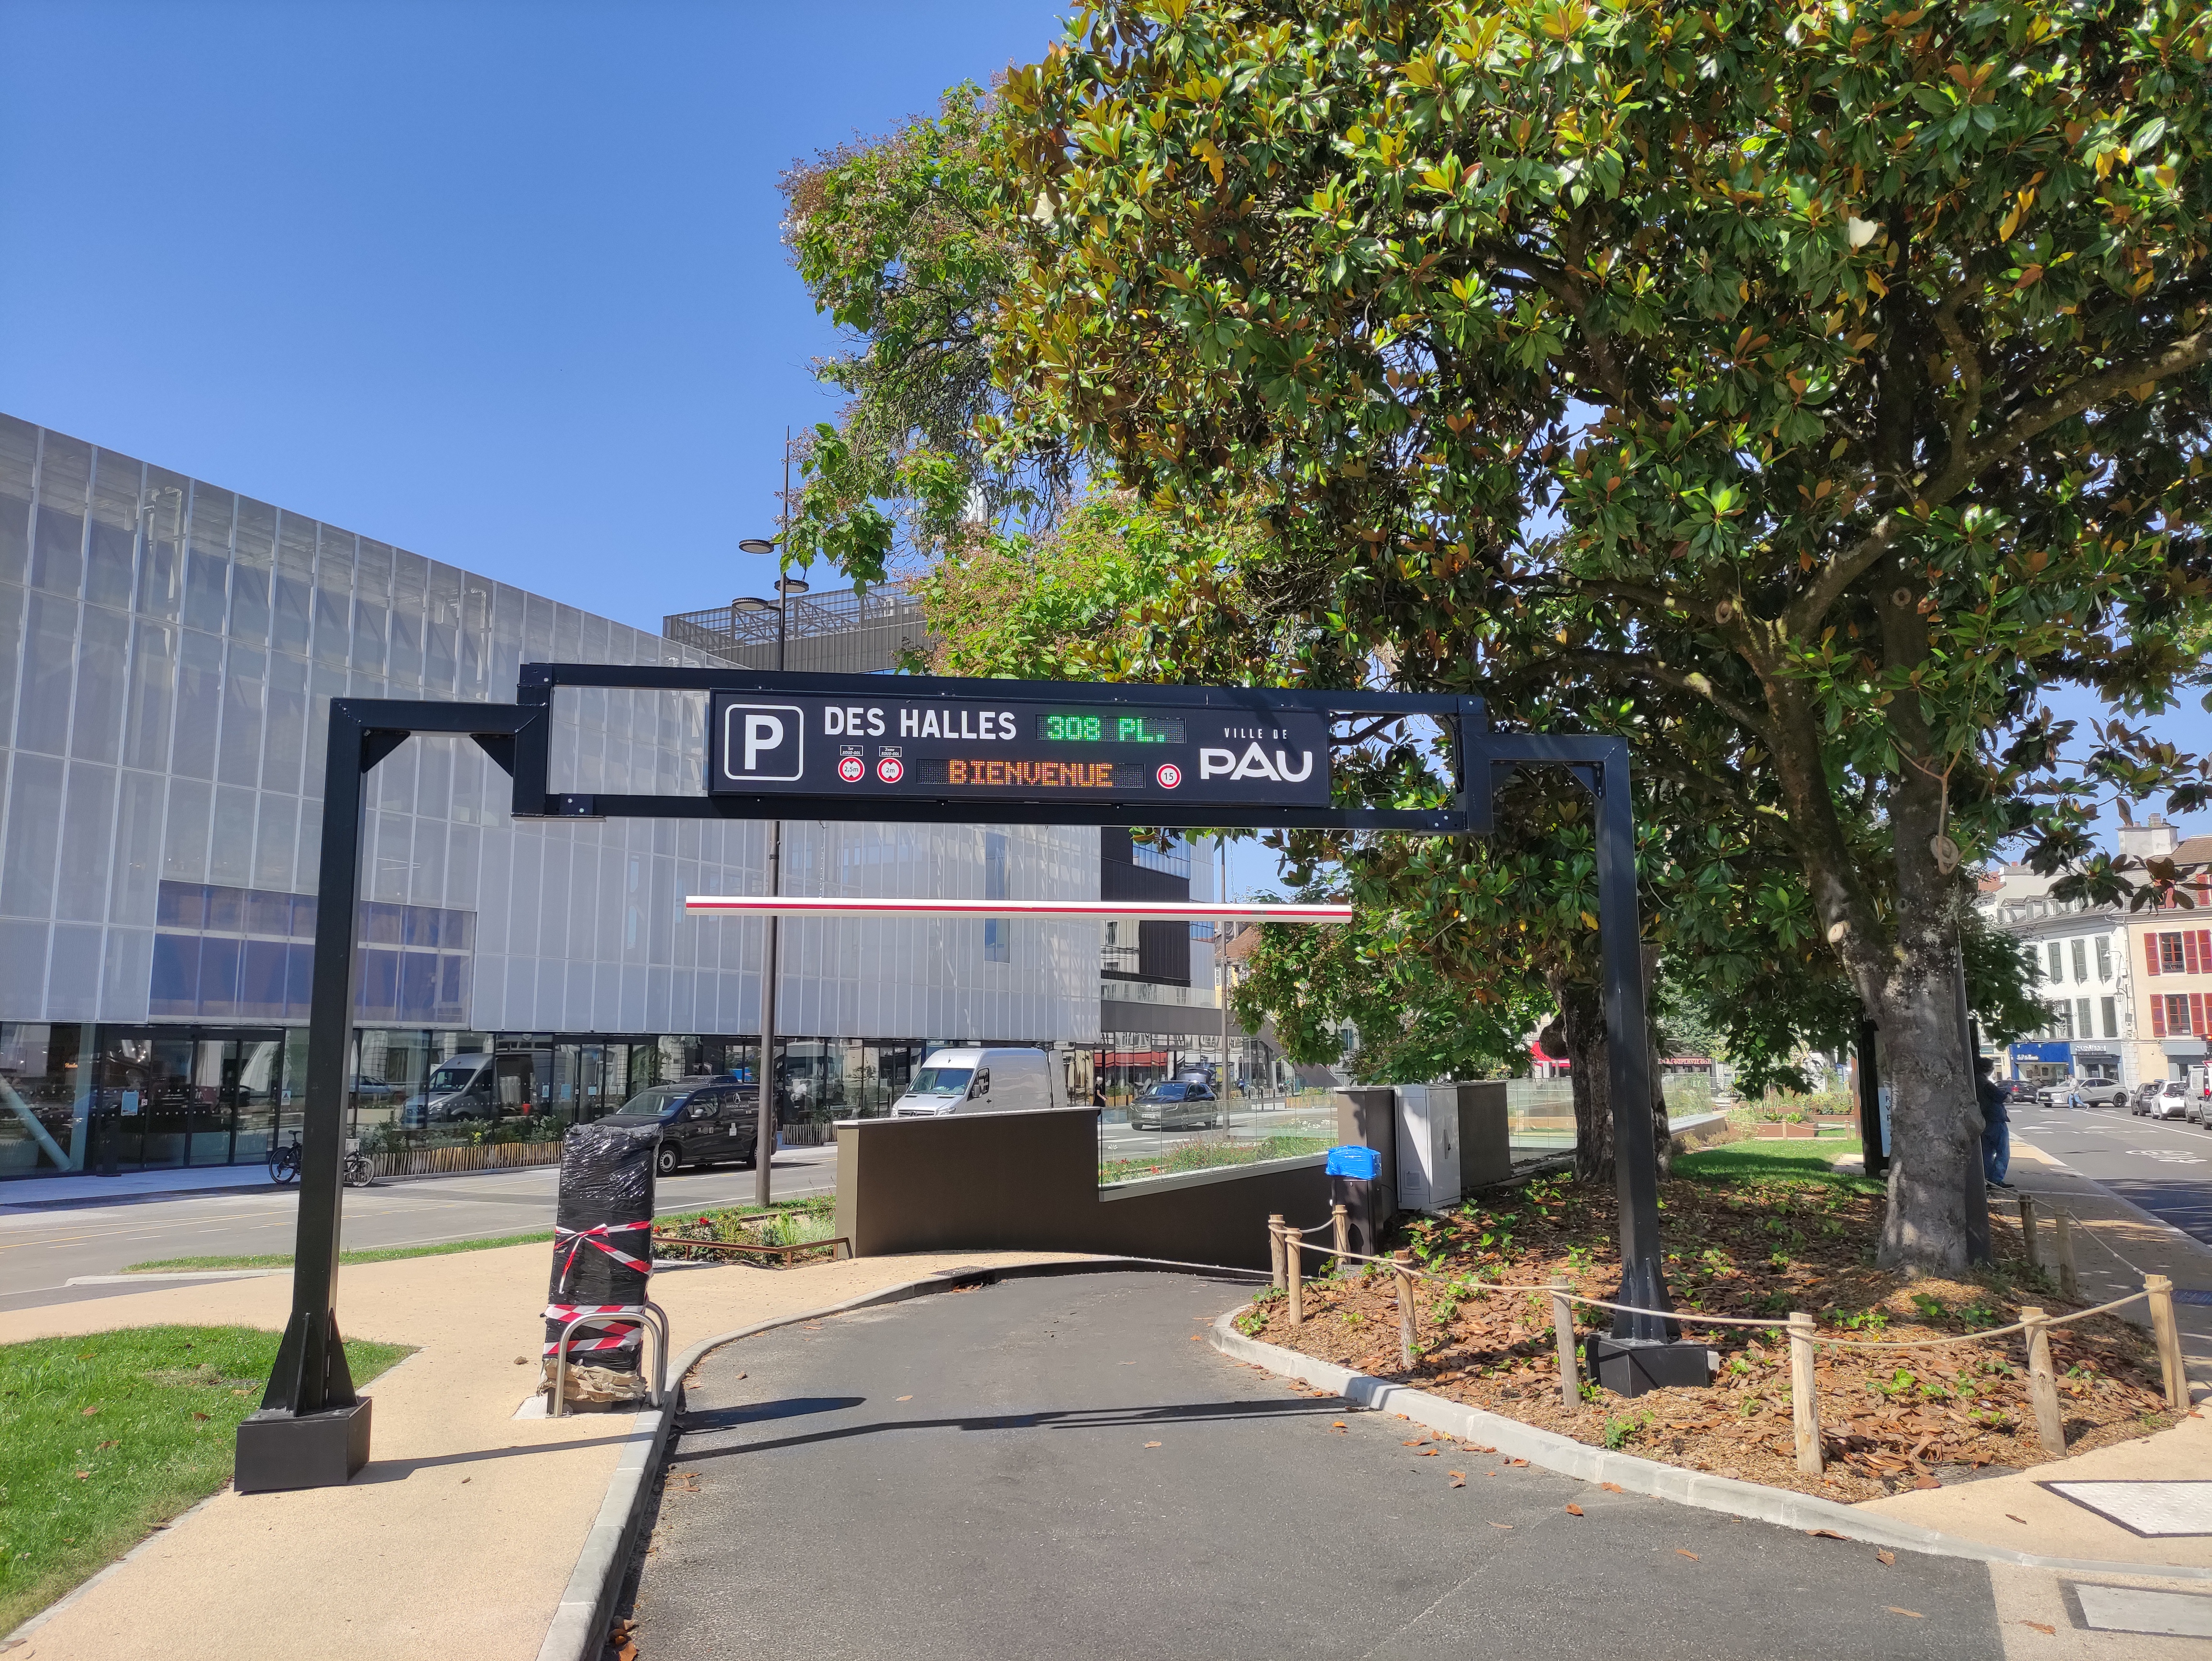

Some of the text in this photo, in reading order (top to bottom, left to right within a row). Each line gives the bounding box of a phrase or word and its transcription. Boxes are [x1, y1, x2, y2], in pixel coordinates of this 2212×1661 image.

[825, 707, 1017, 740] DES HALLES
[1047, 716, 1165, 742] 308 PL.
[1224, 728, 1287, 739] VILLE DE
[744, 714, 784, 770] P
[949, 760, 1113, 787] BIENVENUE
[1200, 742, 1313, 782] PAU
[1163, 772, 1173, 781] 15
